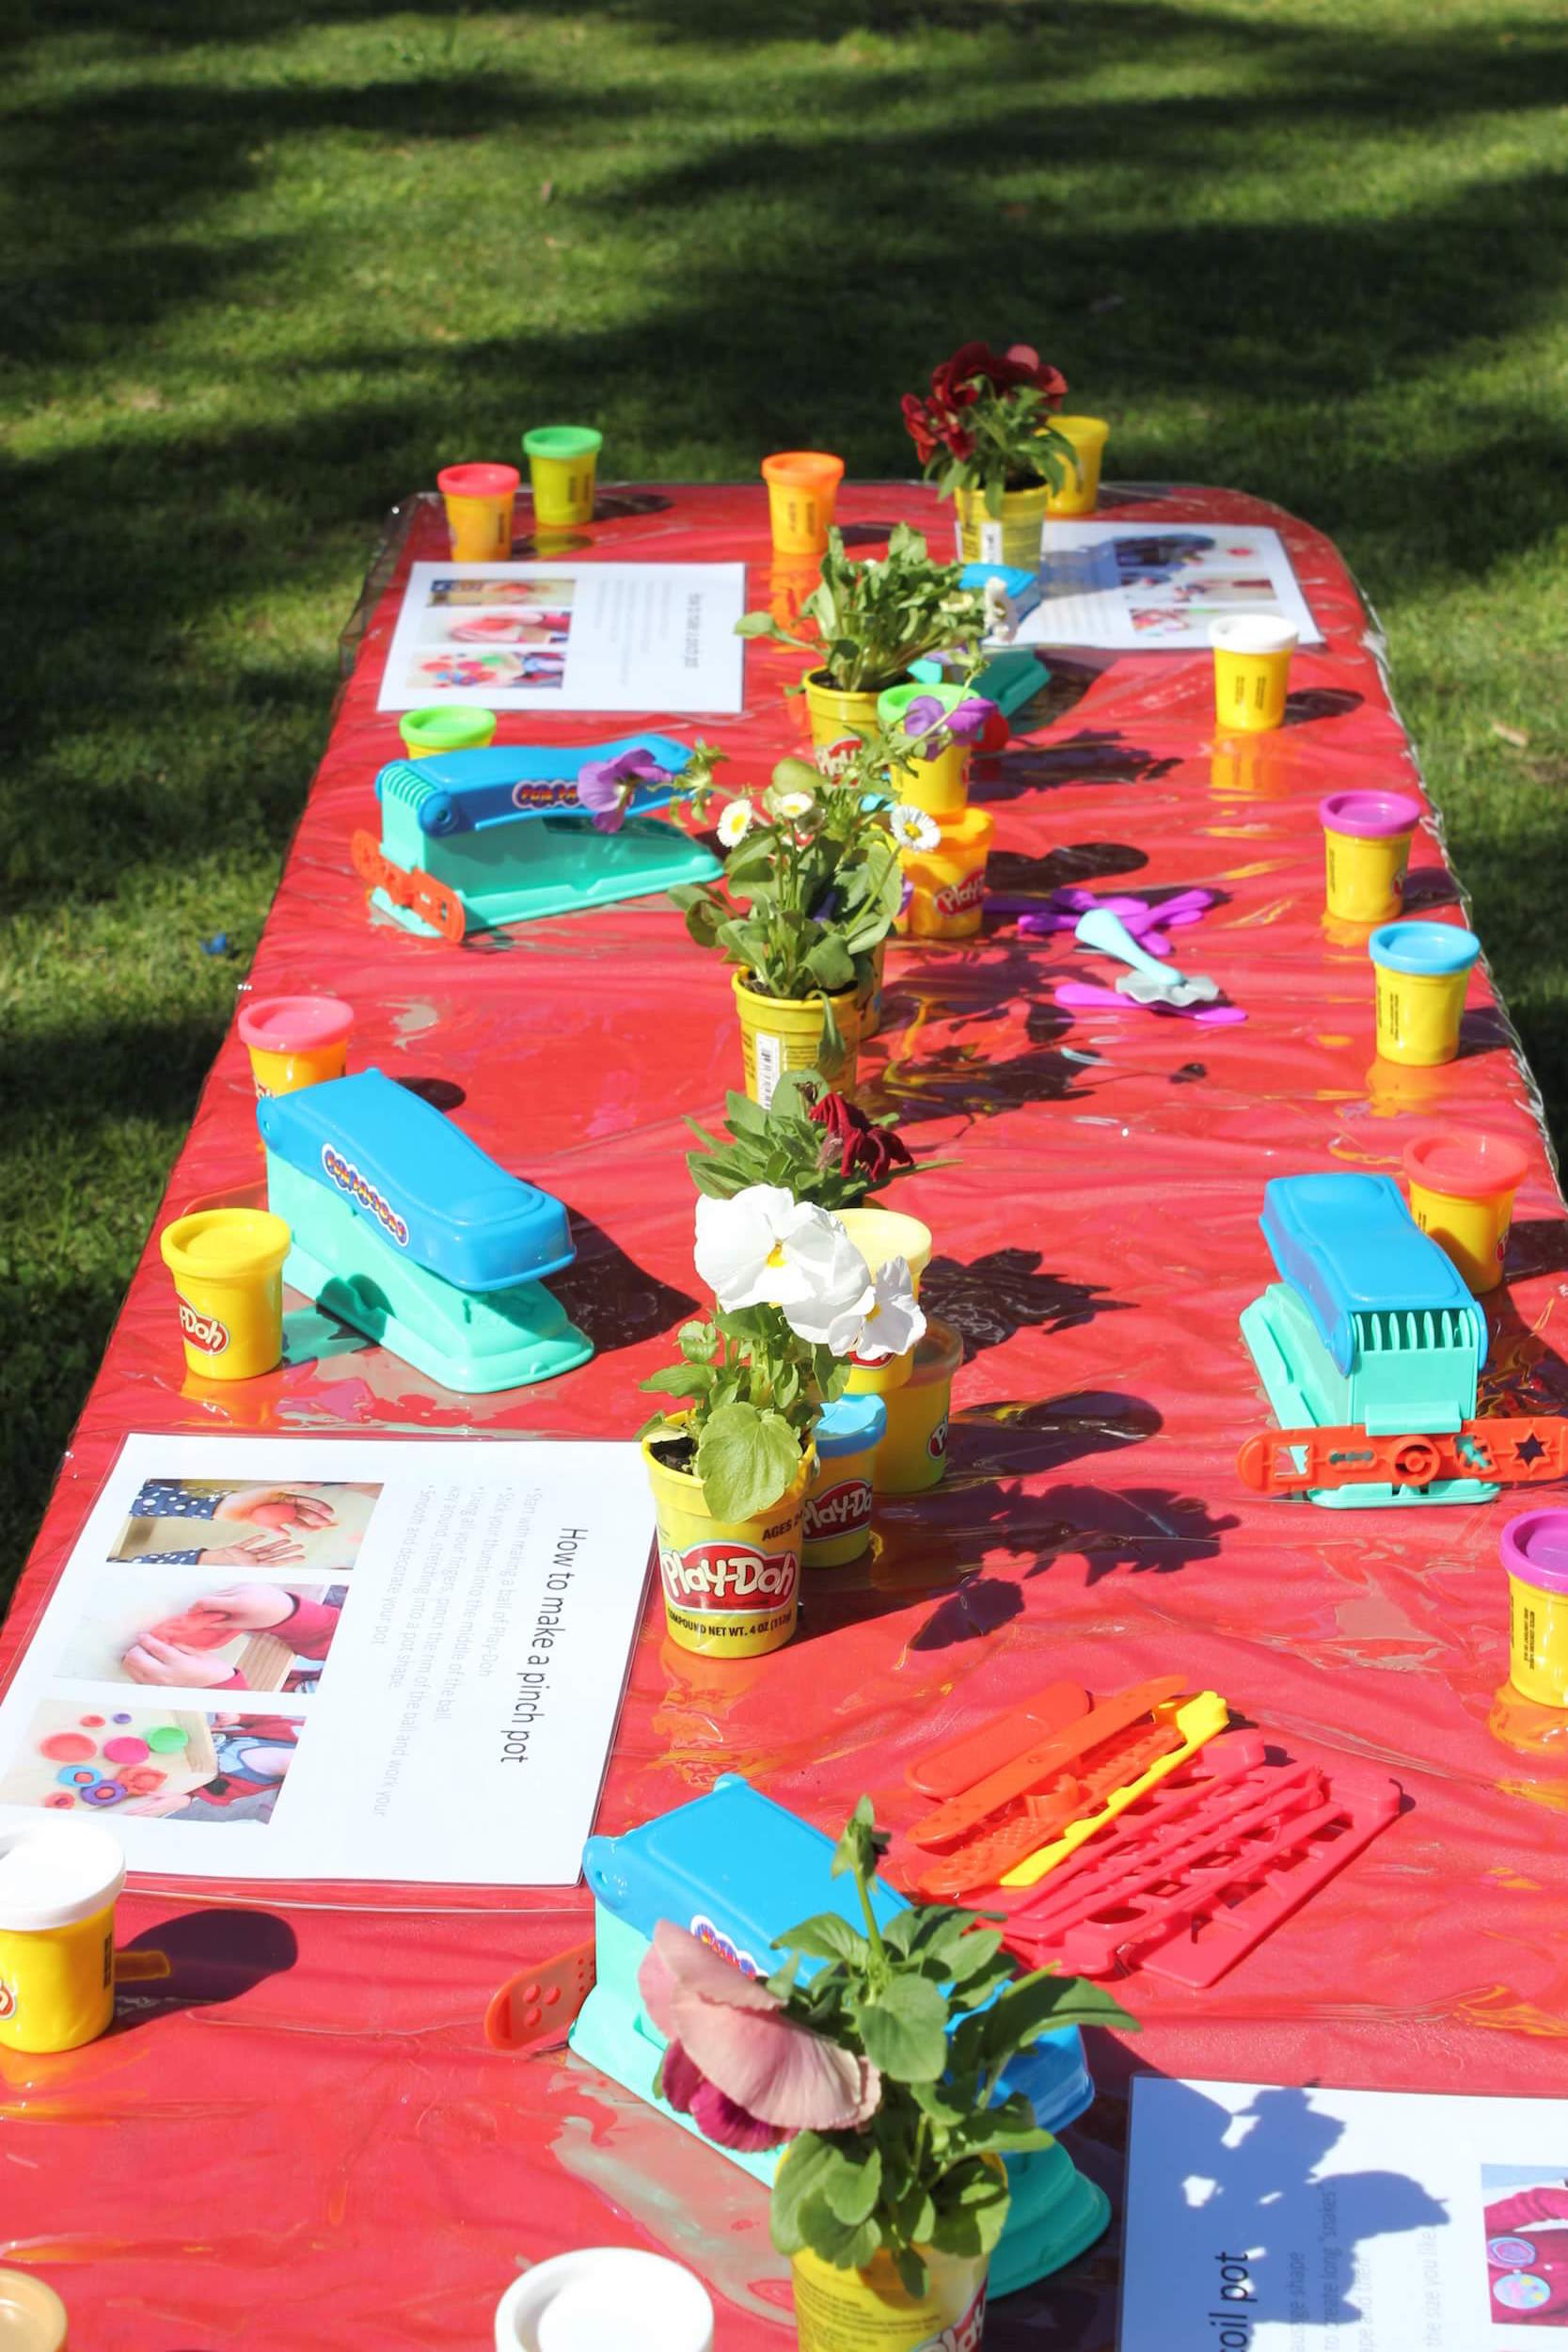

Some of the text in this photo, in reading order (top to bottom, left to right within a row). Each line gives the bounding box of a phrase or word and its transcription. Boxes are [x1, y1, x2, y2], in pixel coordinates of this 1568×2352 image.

[180, 1303, 224, 1349] -Doh
[801, 1486, 873, 1535] Play-Do
[460, 1518, 480, 1530] all
[487, 1516, 504, 1537] your
[515, 1517, 534, 1538] with
[762, 1521, 792, 1542] AGES
[403, 1528, 420, 1545] and
[451, 1533, 468, 1554] your
[475, 1539, 500, 1572] thumb
[499, 1540, 526, 1576] making
[387, 1548, 414, 1594] decorate
[413, 1543, 443, 1594] stretching
[661, 1550, 797, 1598] Play-Doh
[468, 1576, 490, 1597] into
[379, 1597, 400, 1621] your
[409, 1597, 428, 1619] into
[463, 1600, 483, 1618] the
[496, 1589, 517, 1609] ball
[430, 1598, 451, 1629] pinch
[492, 1612, 509, 1624] of
[371, 1626, 389, 1645] pot
[708, 1624, 726, 1637] NET
[729, 1625, 748, 1637] WT.
[749, 1624, 756, 1635] 4
[757, 1622, 769, 1633] OZ
[398, 1632, 417, 1651] pot
[422, 1632, 445, 1651] the
[451, 1621, 475, 1660] middle
[500, 1528, 589, 1763] How to make a pinch pot
[478, 1627, 506, 1677] Play-Doh
[418, 1655, 436, 1673] rim
[447, 1663, 466, 1676] of
[413, 1677, 432, 1689] of
[441, 1678, 461, 1696] the
[406, 1691, 428, 1708] the
[398, 1712, 422, 1732] ball
[391, 1735, 414, 1756] and
[382, 1759, 403, 1788] work
[372, 1790, 392, 1817] your
[1286, 2251, 1306, 2295] shape
[1318, 2249, 1342, 2279] long
[1209, 2251, 1258, 2352] oil pot
